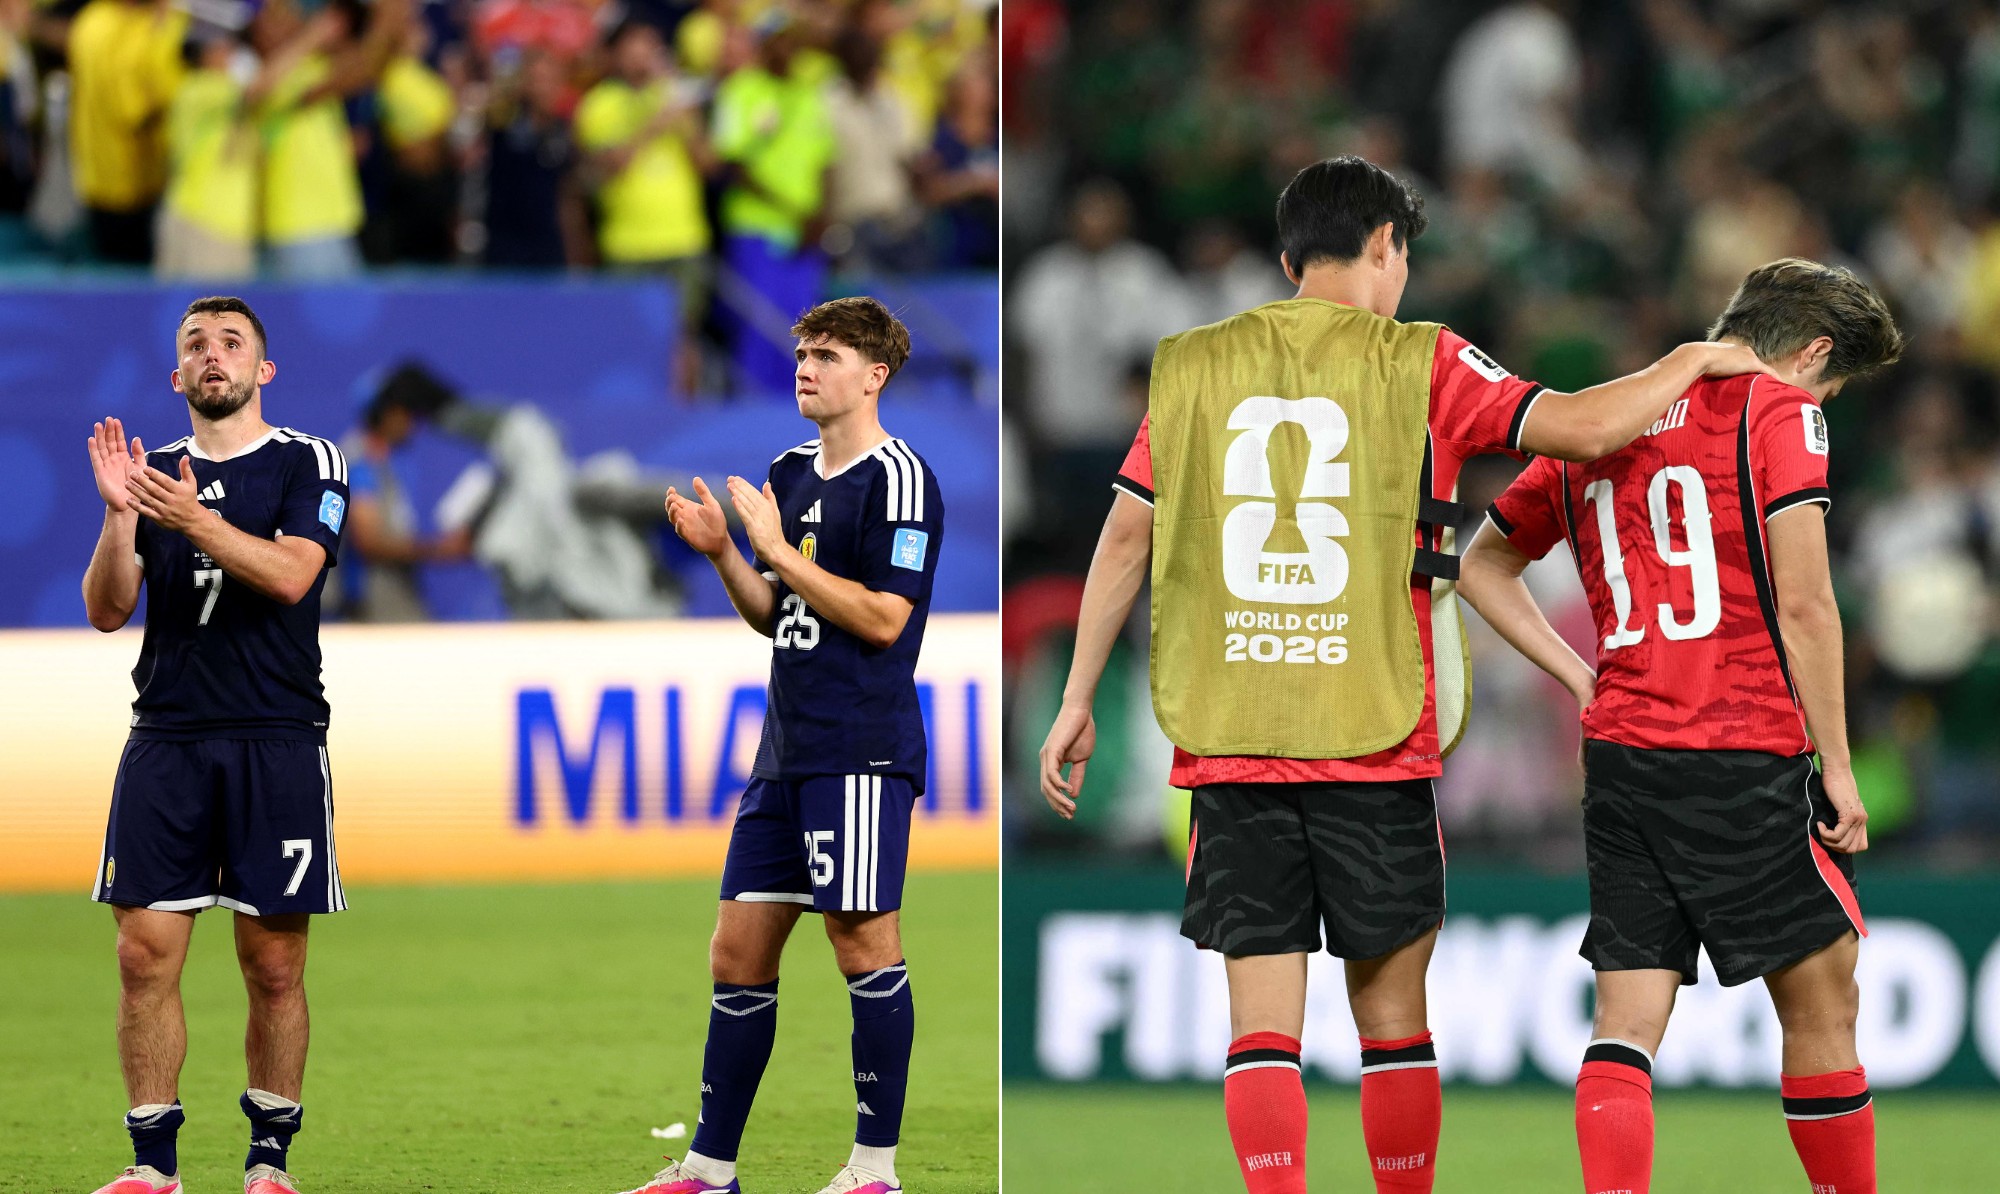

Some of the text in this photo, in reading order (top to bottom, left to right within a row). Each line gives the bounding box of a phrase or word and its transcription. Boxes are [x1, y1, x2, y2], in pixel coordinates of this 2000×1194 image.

[1257, 562, 1316, 585] FIFA
[1584, 465, 1722, 655] 19
[193, 568, 222, 627] 7
[773, 593, 820, 651] 25
[1224, 610, 1349, 632] WORLD CUP
[1224, 632, 1348, 665] 2026
[282, 838, 313, 897] 7
[1245, 1151, 1293, 1172] KOREA
[1376, 1152, 1426, 1171] KOREA
